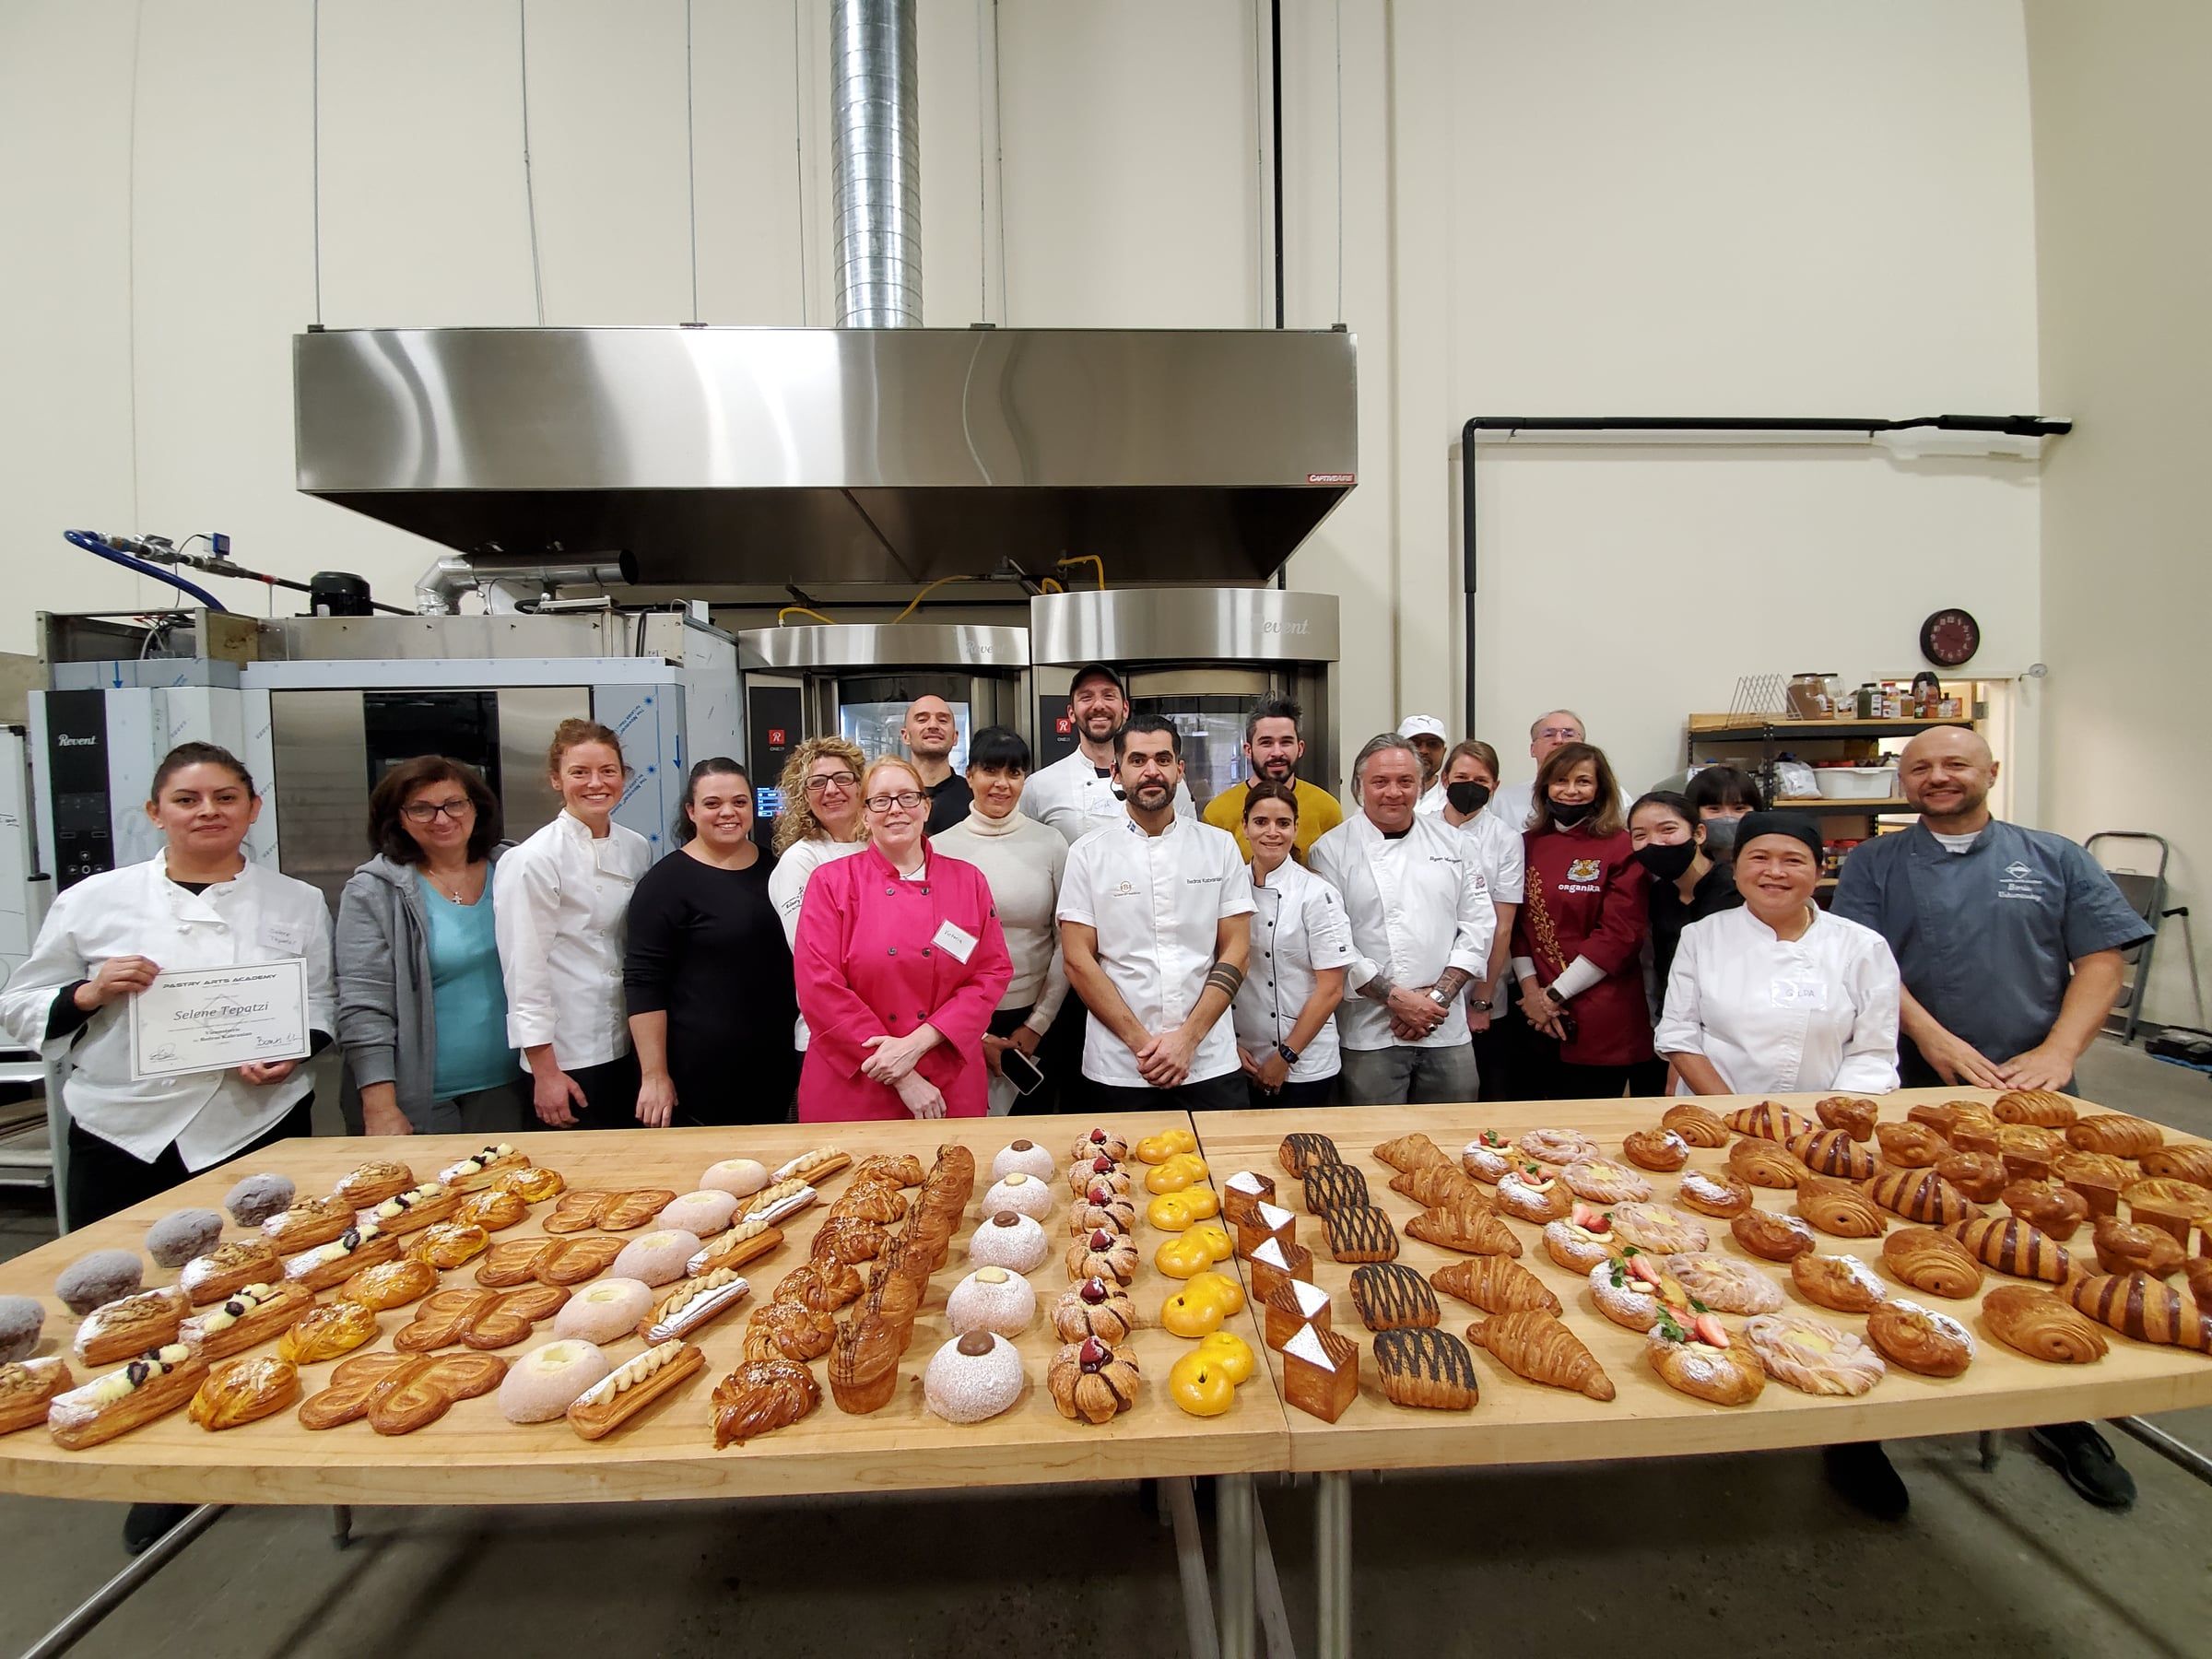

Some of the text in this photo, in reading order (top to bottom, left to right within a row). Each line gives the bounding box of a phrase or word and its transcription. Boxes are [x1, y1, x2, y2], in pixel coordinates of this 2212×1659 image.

[1252, 616, 1312, 634] event
[58, 734, 99, 747] Revent
[232, 974, 277, 982] ACADEMY
[173, 1002, 269, 1021] Selene Tepatzi
